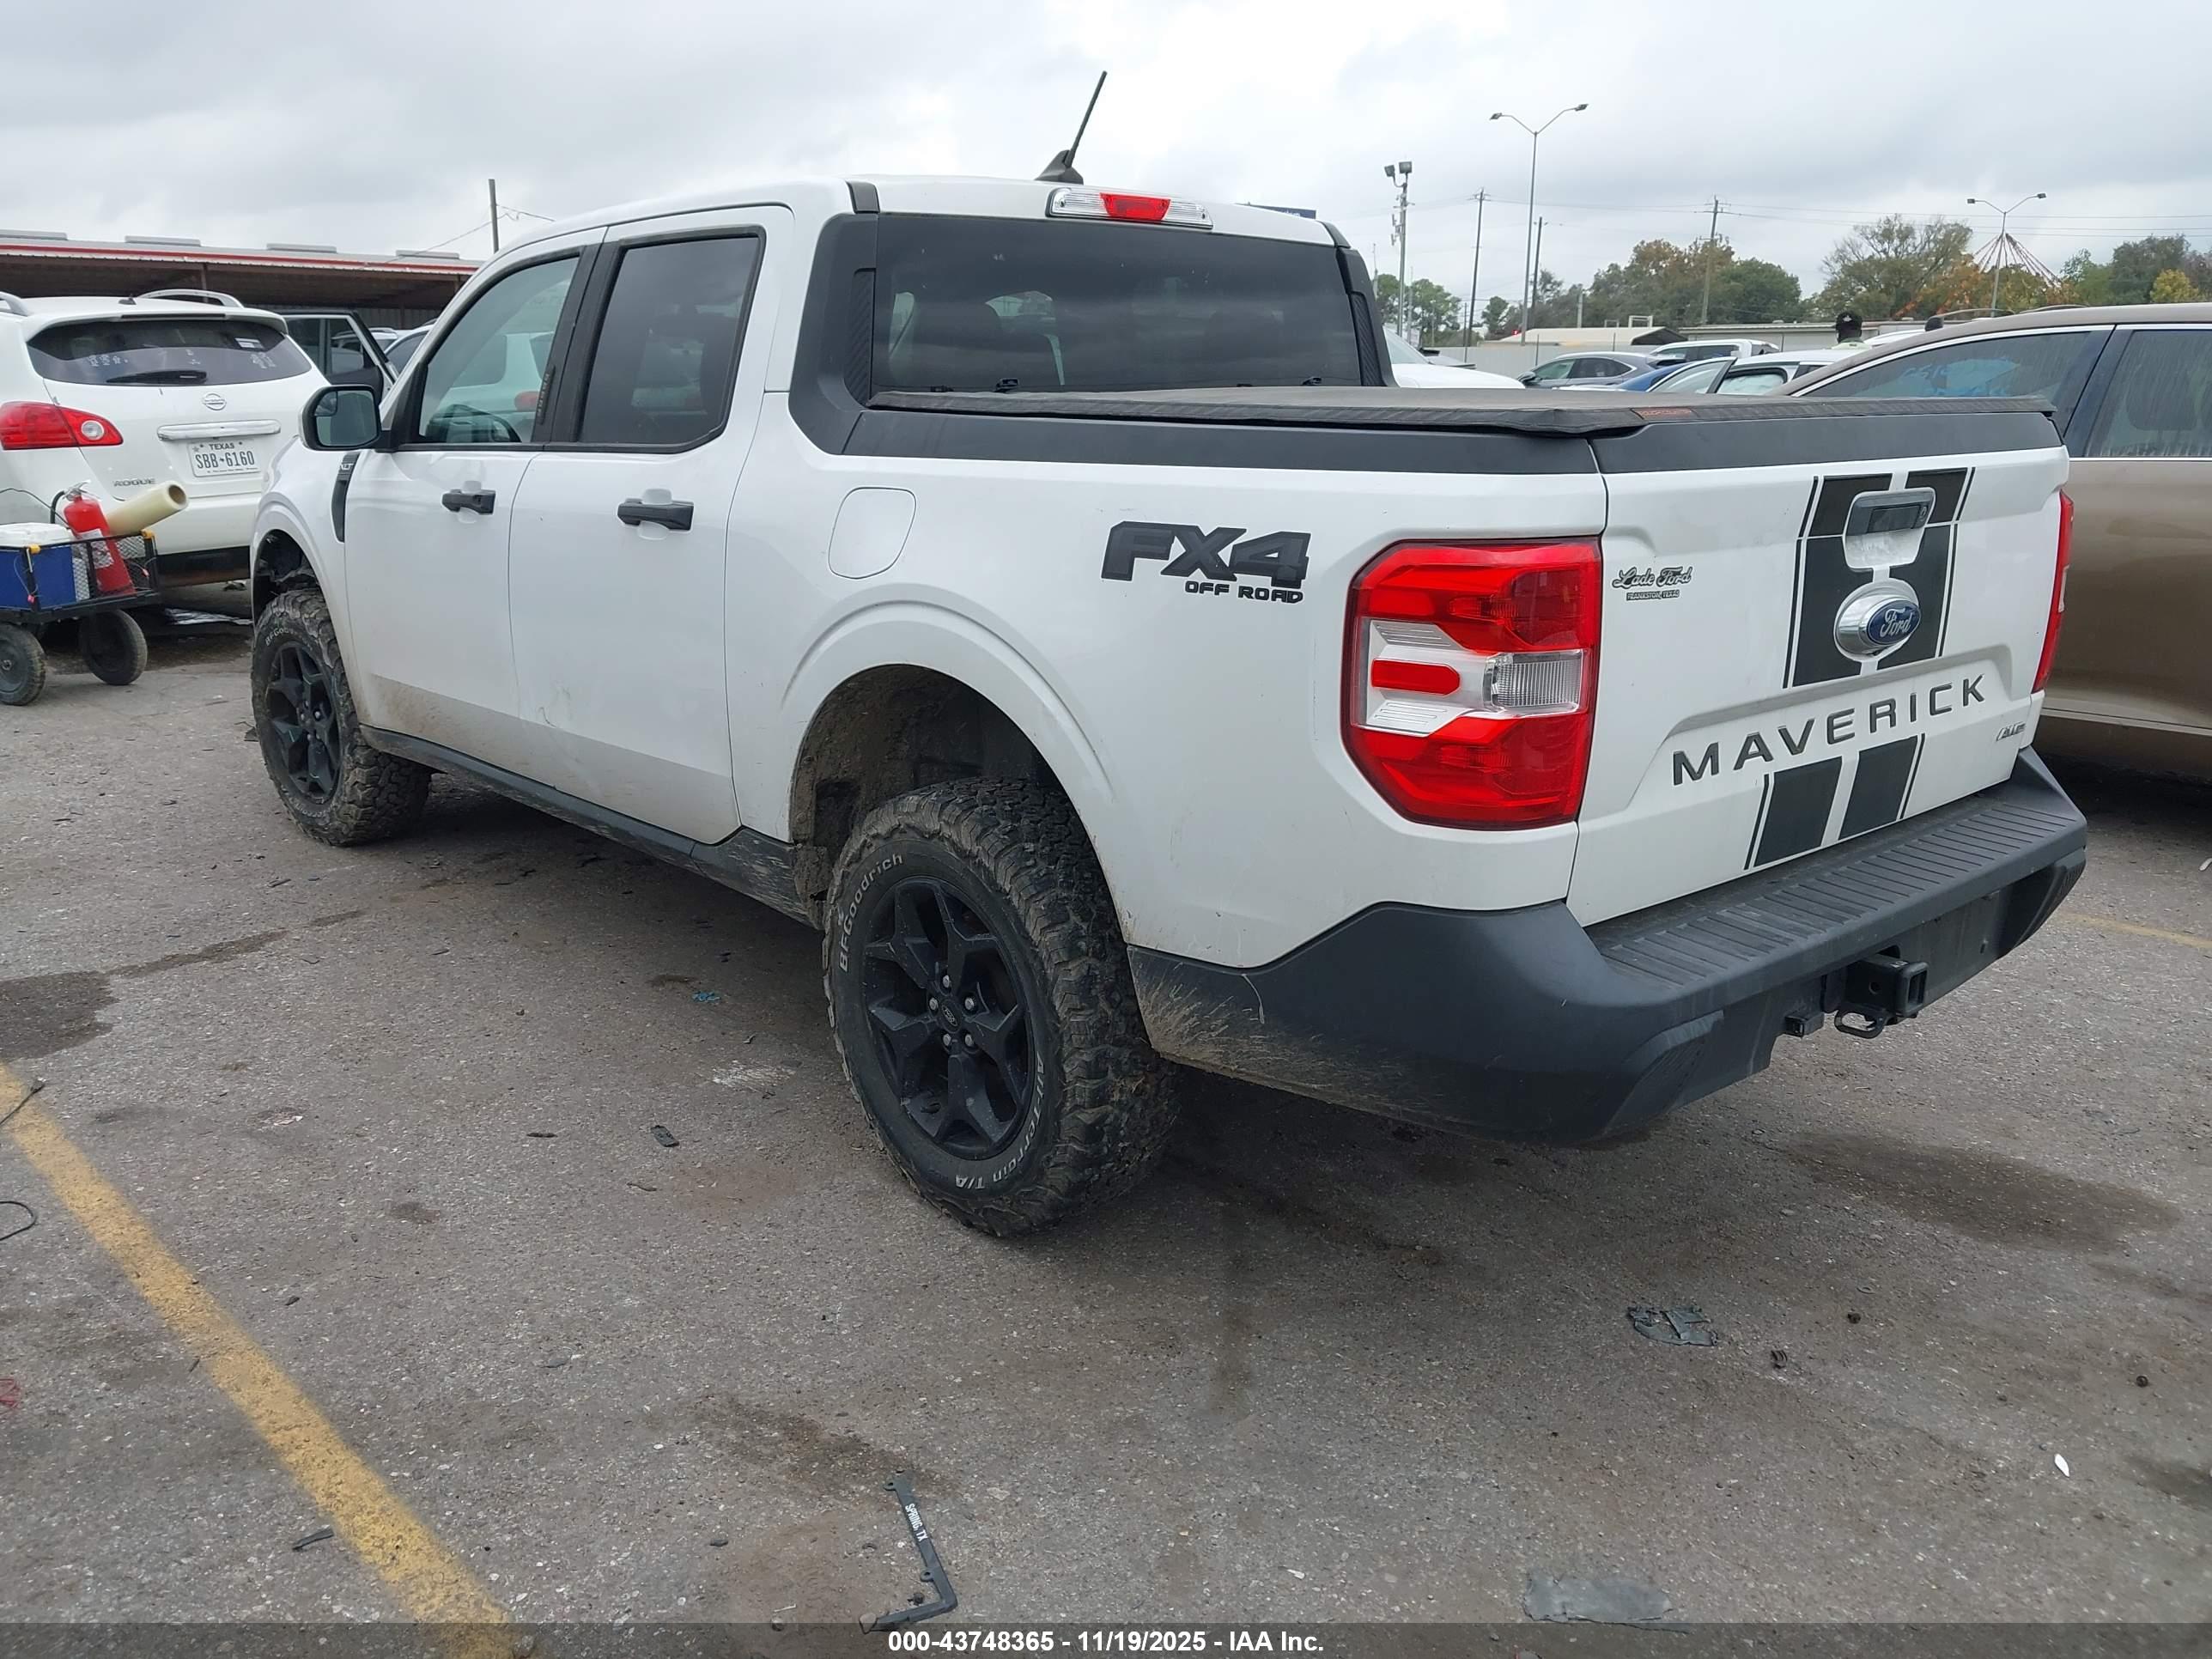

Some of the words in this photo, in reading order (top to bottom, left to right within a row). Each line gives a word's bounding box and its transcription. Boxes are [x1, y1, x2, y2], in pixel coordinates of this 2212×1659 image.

[1100, 520, 1312, 589] FX4
[1612, 567, 1656, 590] Lade
[1656, 566, 1693, 587] Ford
[1184, 580, 1231, 597] OFF
[1237, 585, 1304, 605] ROAD
[1880, 607, 1914, 638] Ford
[1672, 674, 1987, 787] MAVERICK
[839, 853, 903, 973] BFGoodrich
[955, 1174, 986, 1189] T/A
[916, 1528, 928, 1542] TX
